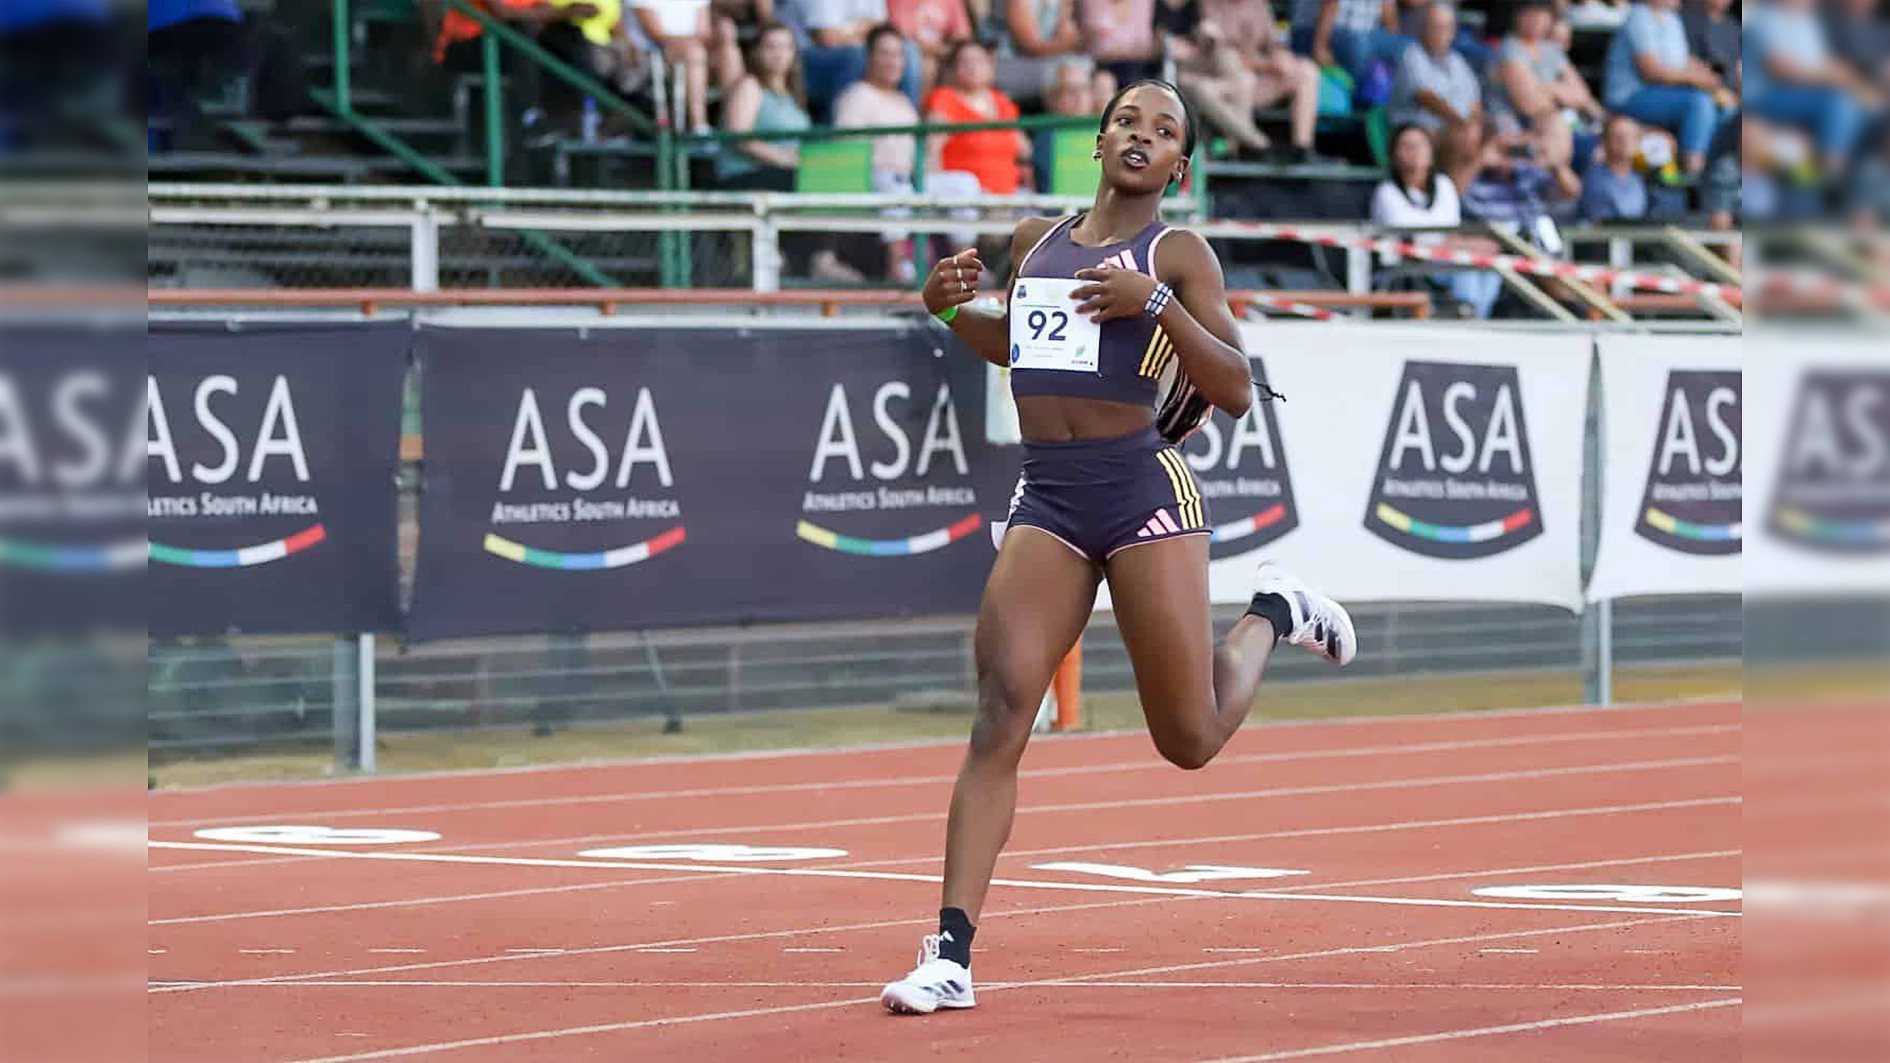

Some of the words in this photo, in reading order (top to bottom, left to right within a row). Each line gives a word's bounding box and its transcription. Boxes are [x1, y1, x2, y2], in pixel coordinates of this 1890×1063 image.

[1028, 310, 1068, 341] 92
[500, 387, 673, 491] ASA
[809, 381, 969, 481] ASA
[1186, 382, 1276, 472] SA
[1389, 380, 1524, 474] ASA
[1658, 387, 1742, 476] AS
[148, 497, 197, 516] LETICS
[200, 492, 257, 515] SOUTH
[260, 492, 318, 514] AFRICA
[491, 502, 571, 523] ATHLETICS
[572, 498, 625, 520] SOUTH
[626, 498, 680, 518] AFRICA
